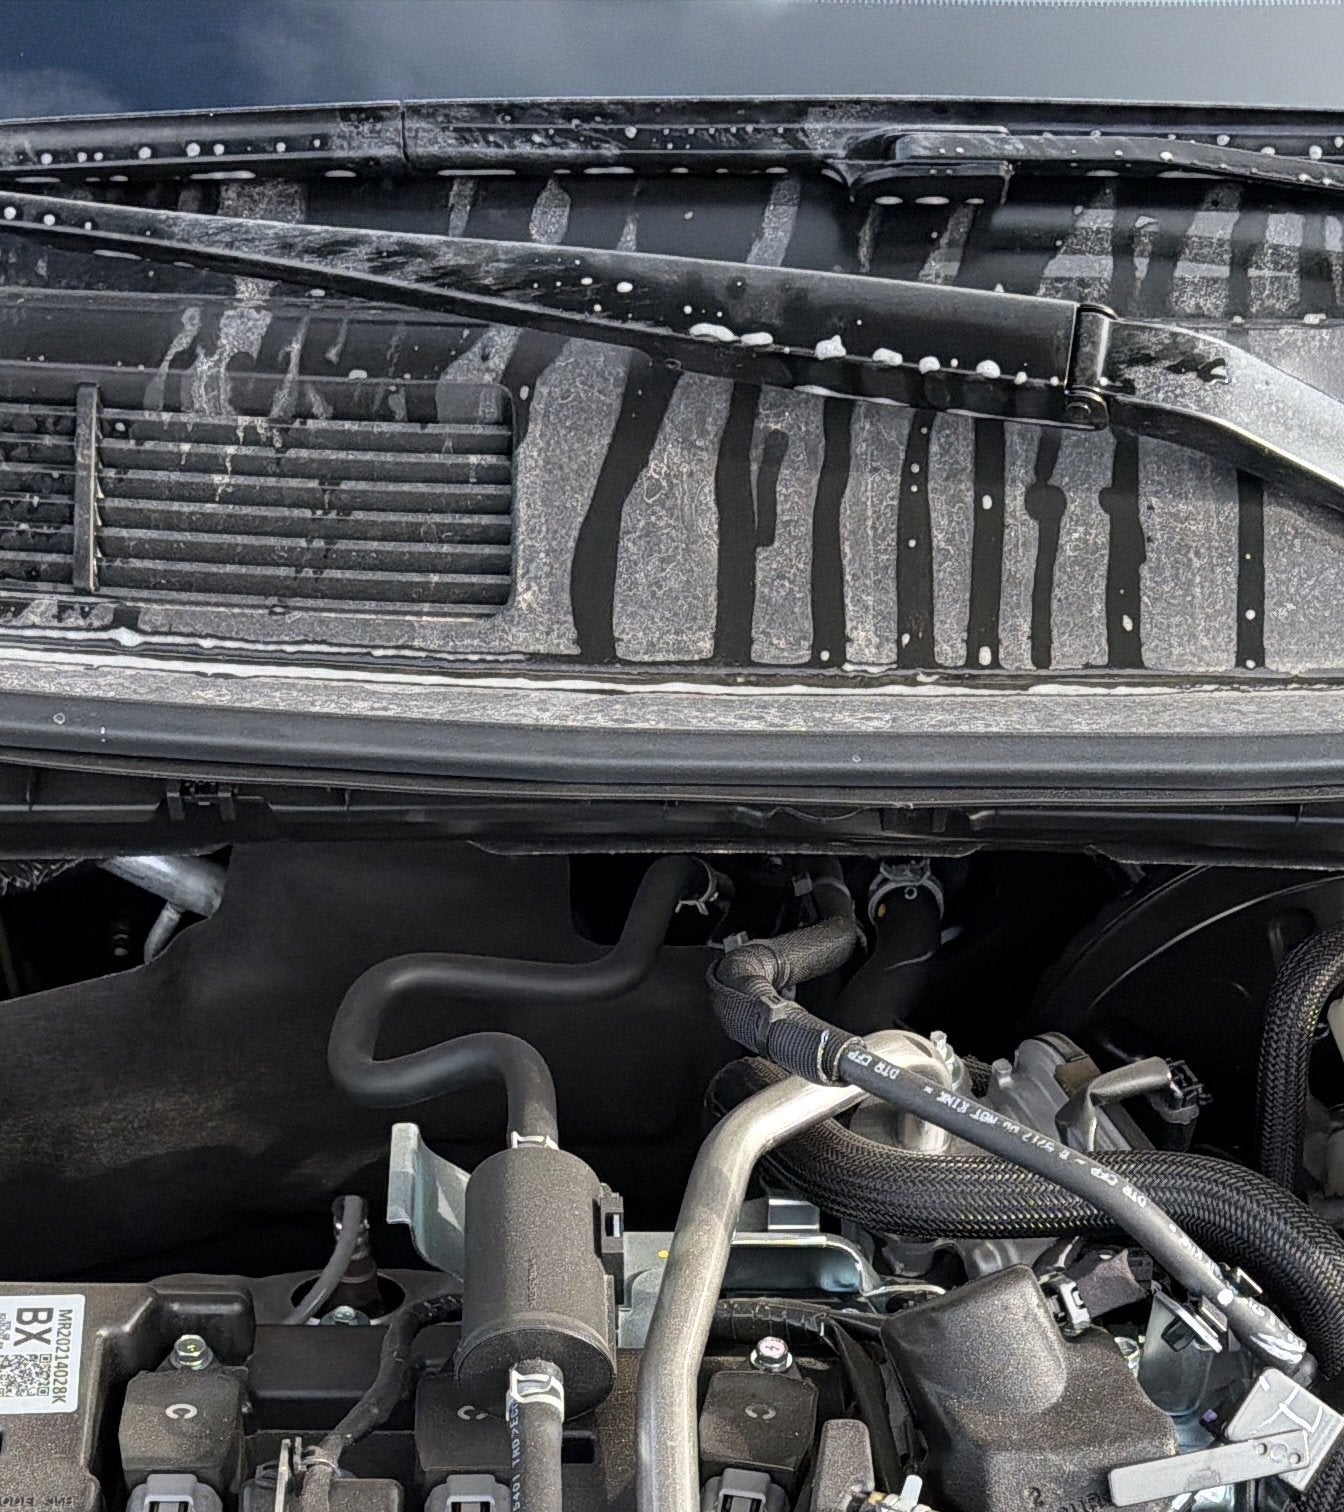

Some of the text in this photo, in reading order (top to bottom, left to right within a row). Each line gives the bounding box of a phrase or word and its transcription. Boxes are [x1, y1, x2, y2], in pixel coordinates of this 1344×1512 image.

[847, 1050, 873, 1068] CFP
[875, 1062, 901, 1080] DTR
[13, 1308, 54, 1347] BX
[52, 1309, 73, 1404] MR20214028K
